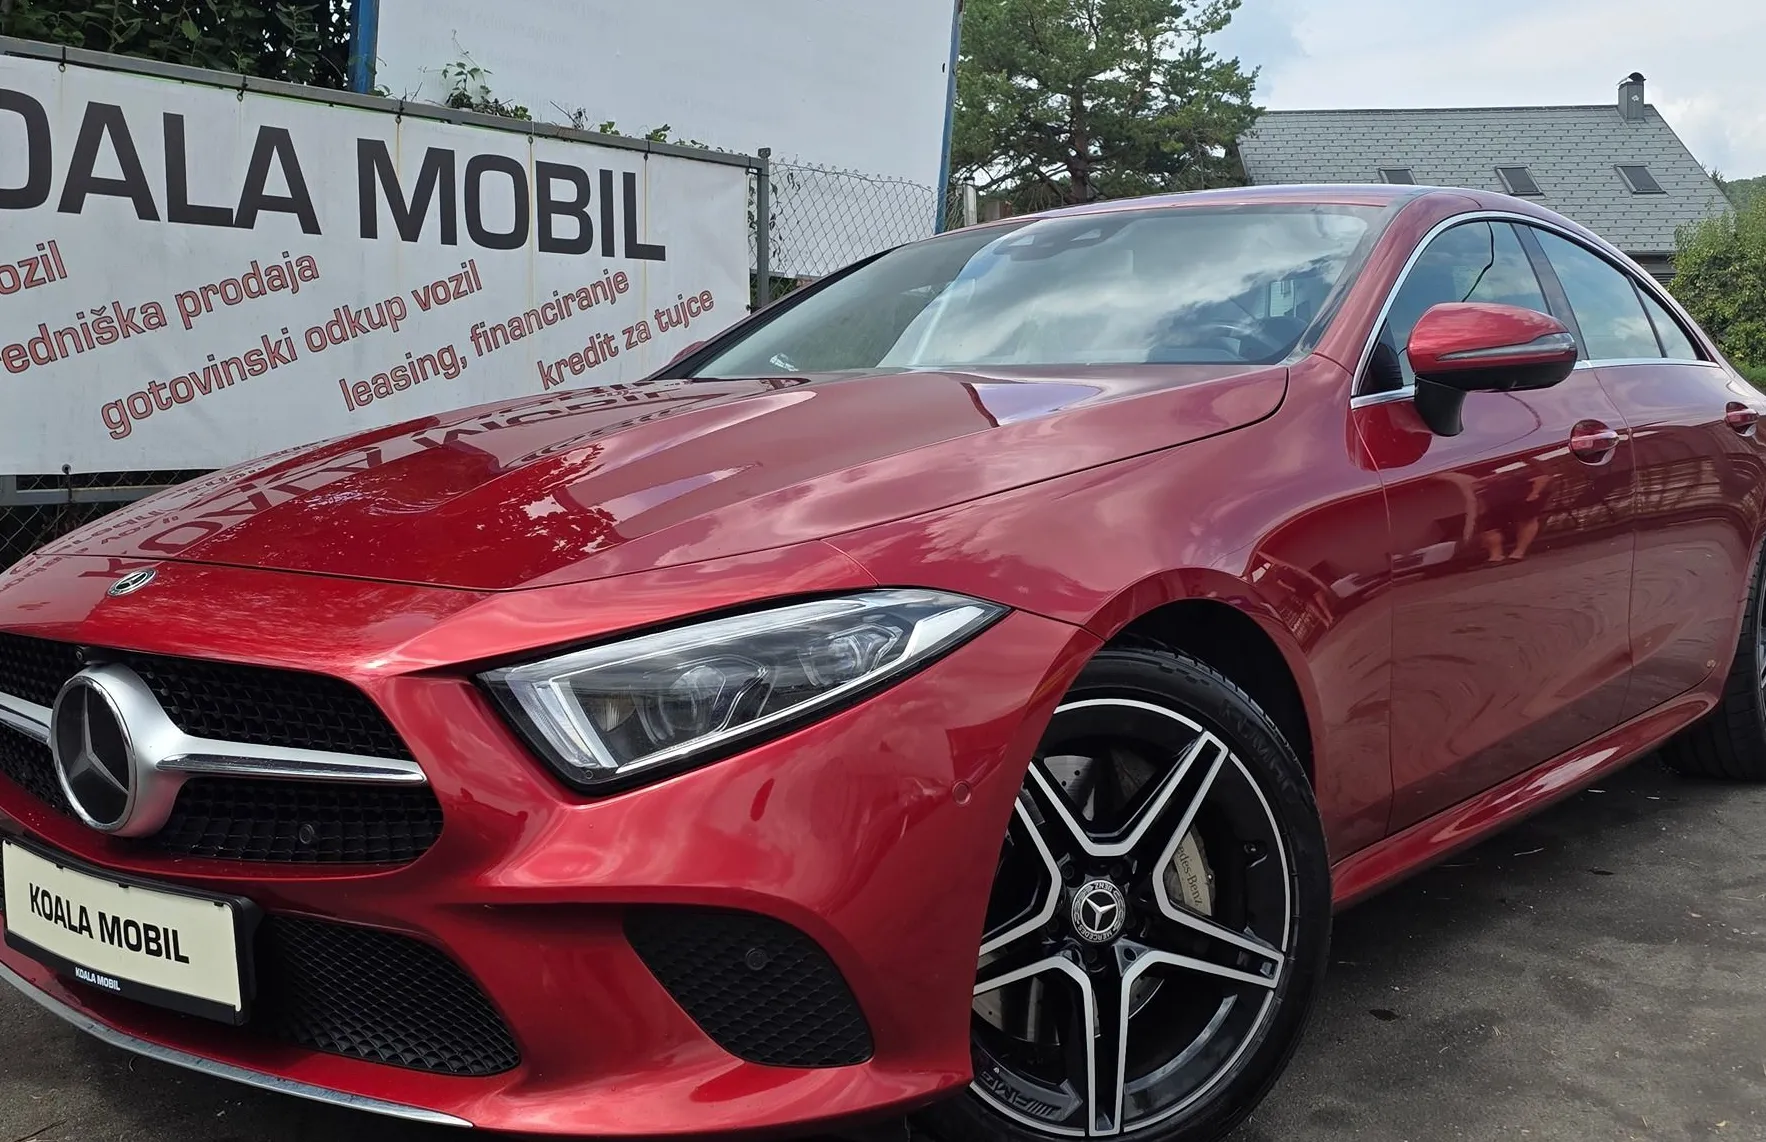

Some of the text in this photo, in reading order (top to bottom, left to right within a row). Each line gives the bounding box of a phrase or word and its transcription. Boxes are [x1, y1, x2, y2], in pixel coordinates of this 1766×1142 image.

[0, 88, 667, 262] OALA MOBIL
[0, 239, 68, 295] ozil
[0, 250, 321, 374] edniška prodaja
[100, 258, 484, 440] gotovinski odkup vozil
[338, 268, 631, 412] leasing, financiranje
[536, 288, 715, 390] kredit za tujce
[28, 881, 190, 965] KOALA MOBIL
[1177, 844, 1203, 907] edes-Benz
[75, 966, 121, 991] KOALA MOBIL
